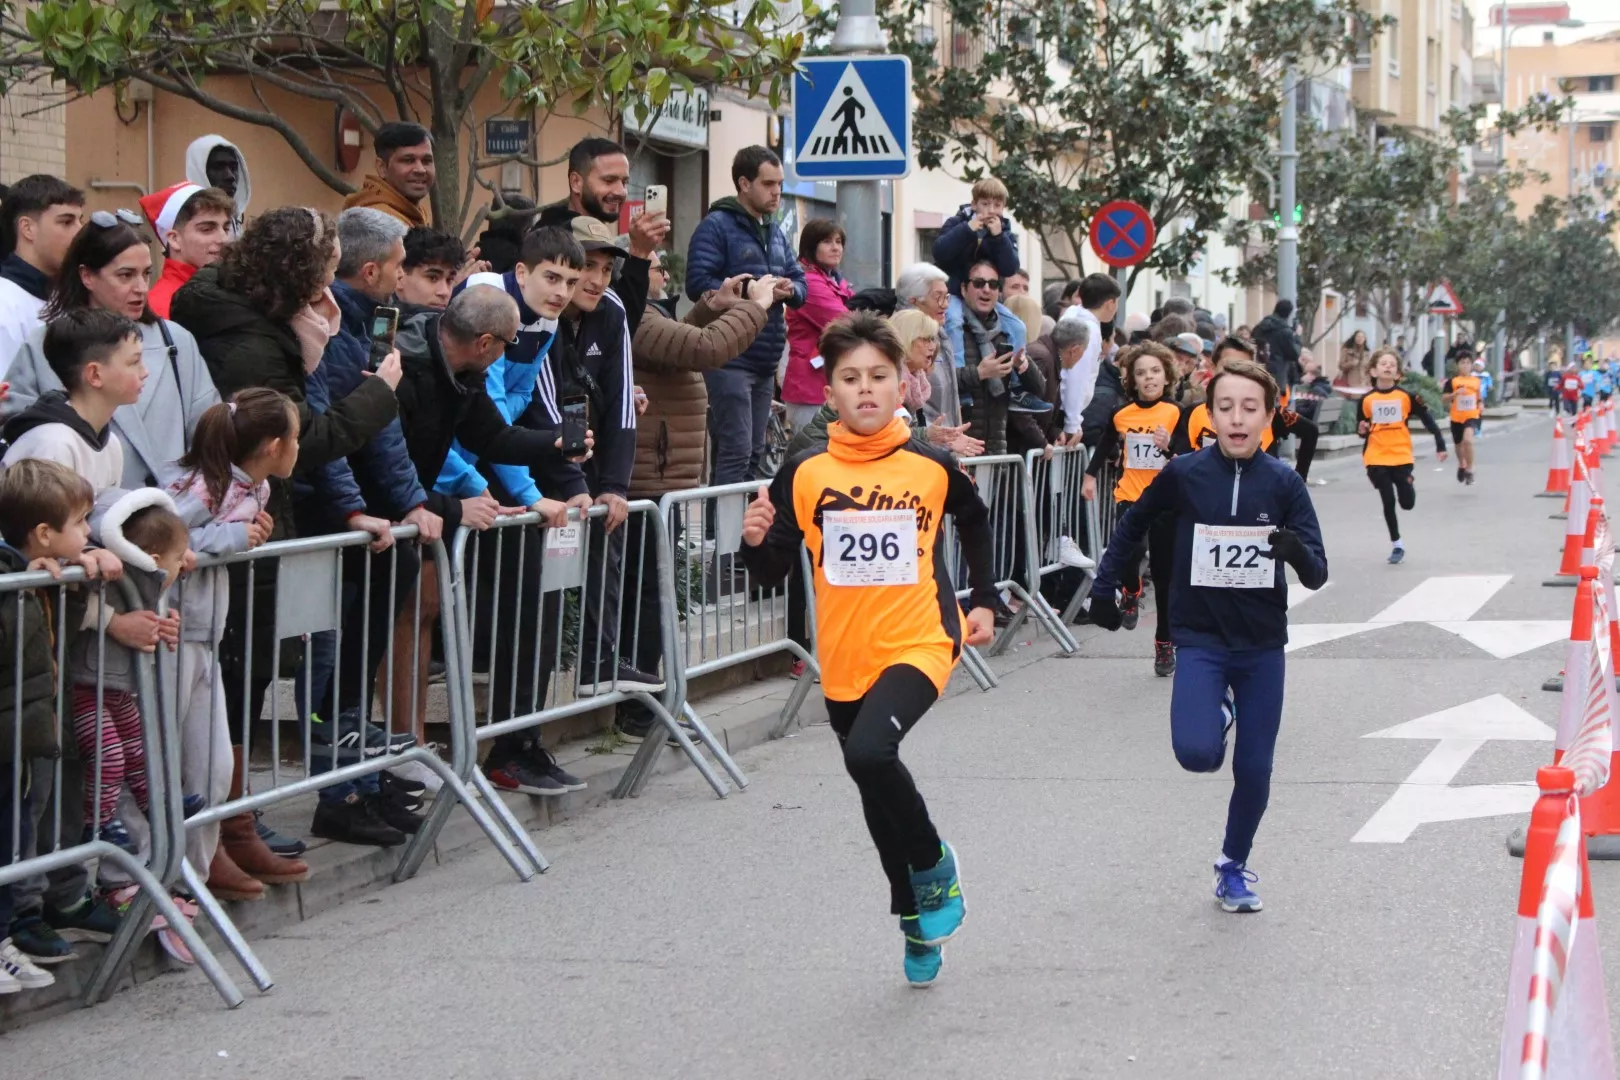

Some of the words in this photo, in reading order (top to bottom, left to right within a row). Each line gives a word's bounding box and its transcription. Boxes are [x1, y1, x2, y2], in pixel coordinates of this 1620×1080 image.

[1378, 407, 1397, 417] 100
[1133, 444, 1162, 458] 173
[839, 532, 900, 562] 296
[1209, 544, 1260, 568] 122
